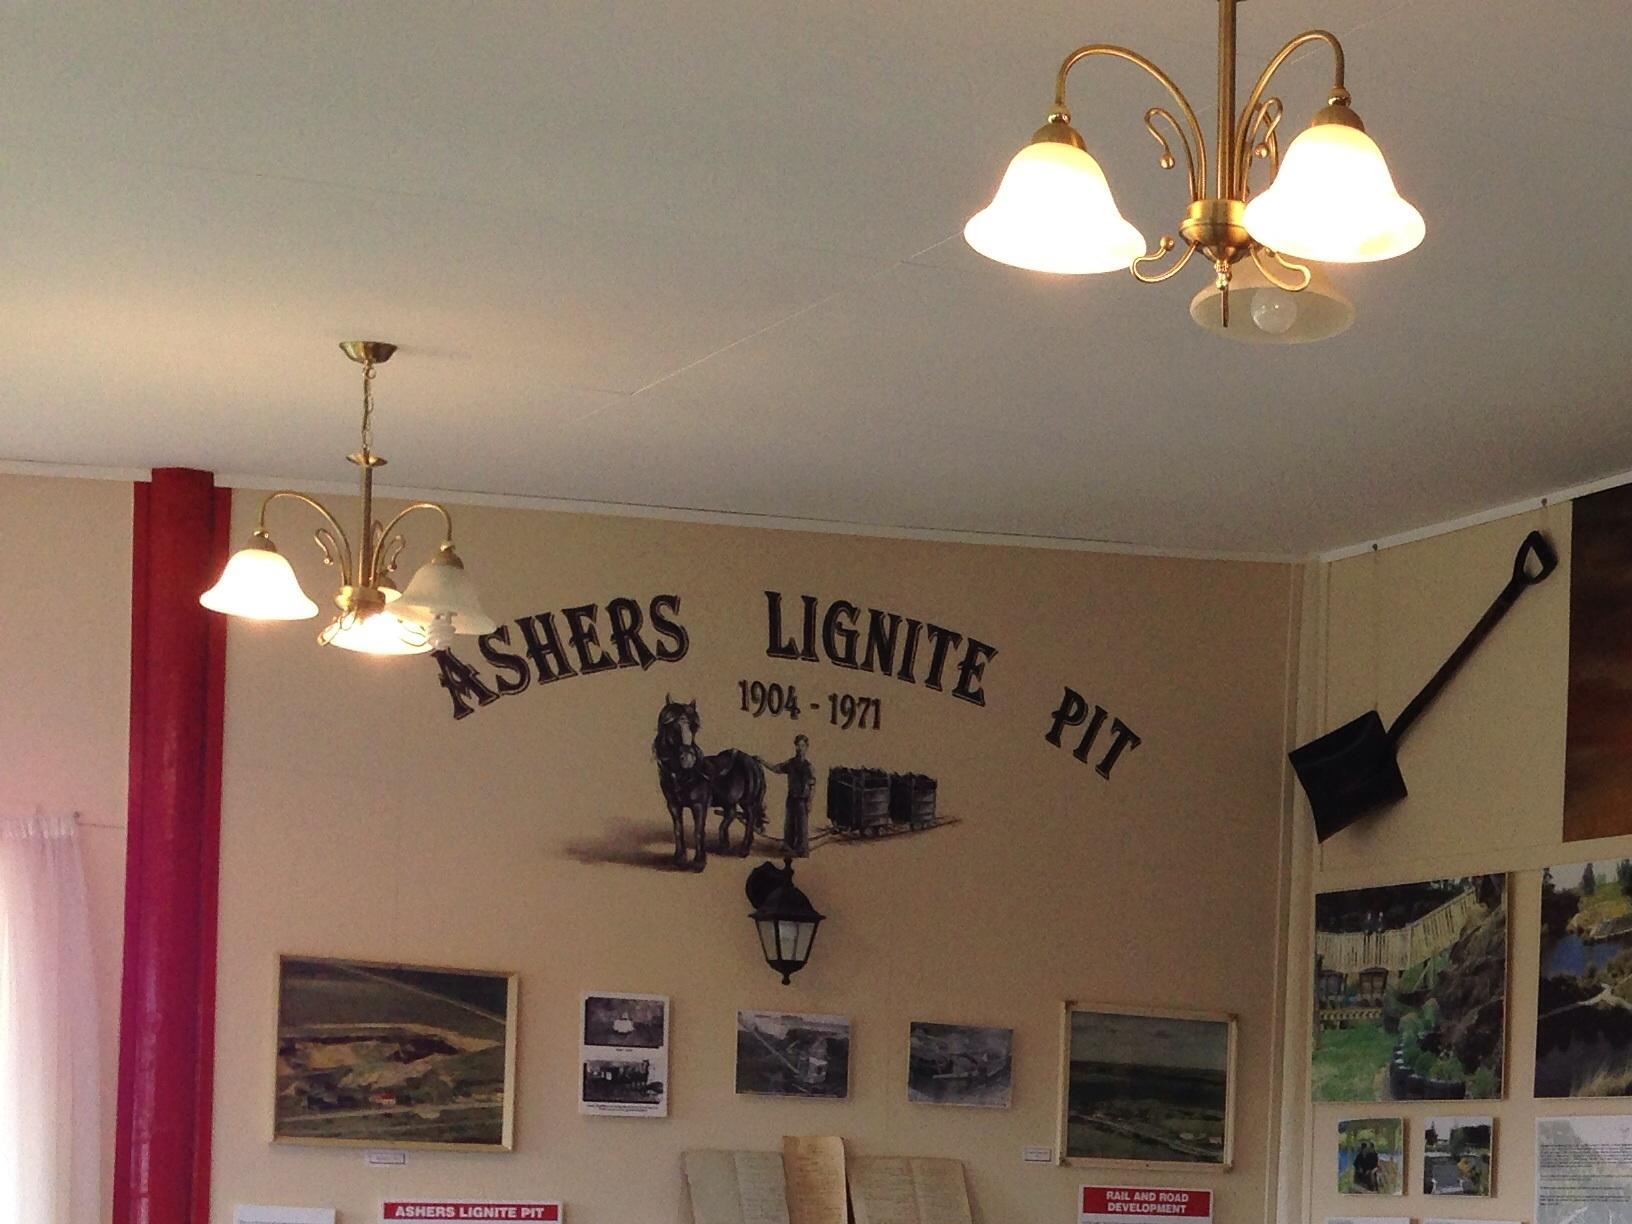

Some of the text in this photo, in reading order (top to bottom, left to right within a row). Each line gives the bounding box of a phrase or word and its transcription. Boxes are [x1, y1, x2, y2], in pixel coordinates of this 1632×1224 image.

[430, 590, 1142, 781] ASHERS LIGNITE PIT
[738, 679, 801, 720] 1904
[828, 692, 881, 731] 1971
[1106, 1190, 1190, 1203] RAIL AND ROAD
[395, 1205, 545, 1219] ASHERS LIGNITE PIT
[1107, 1202, 1188, 1214] DEVELOPMENT
